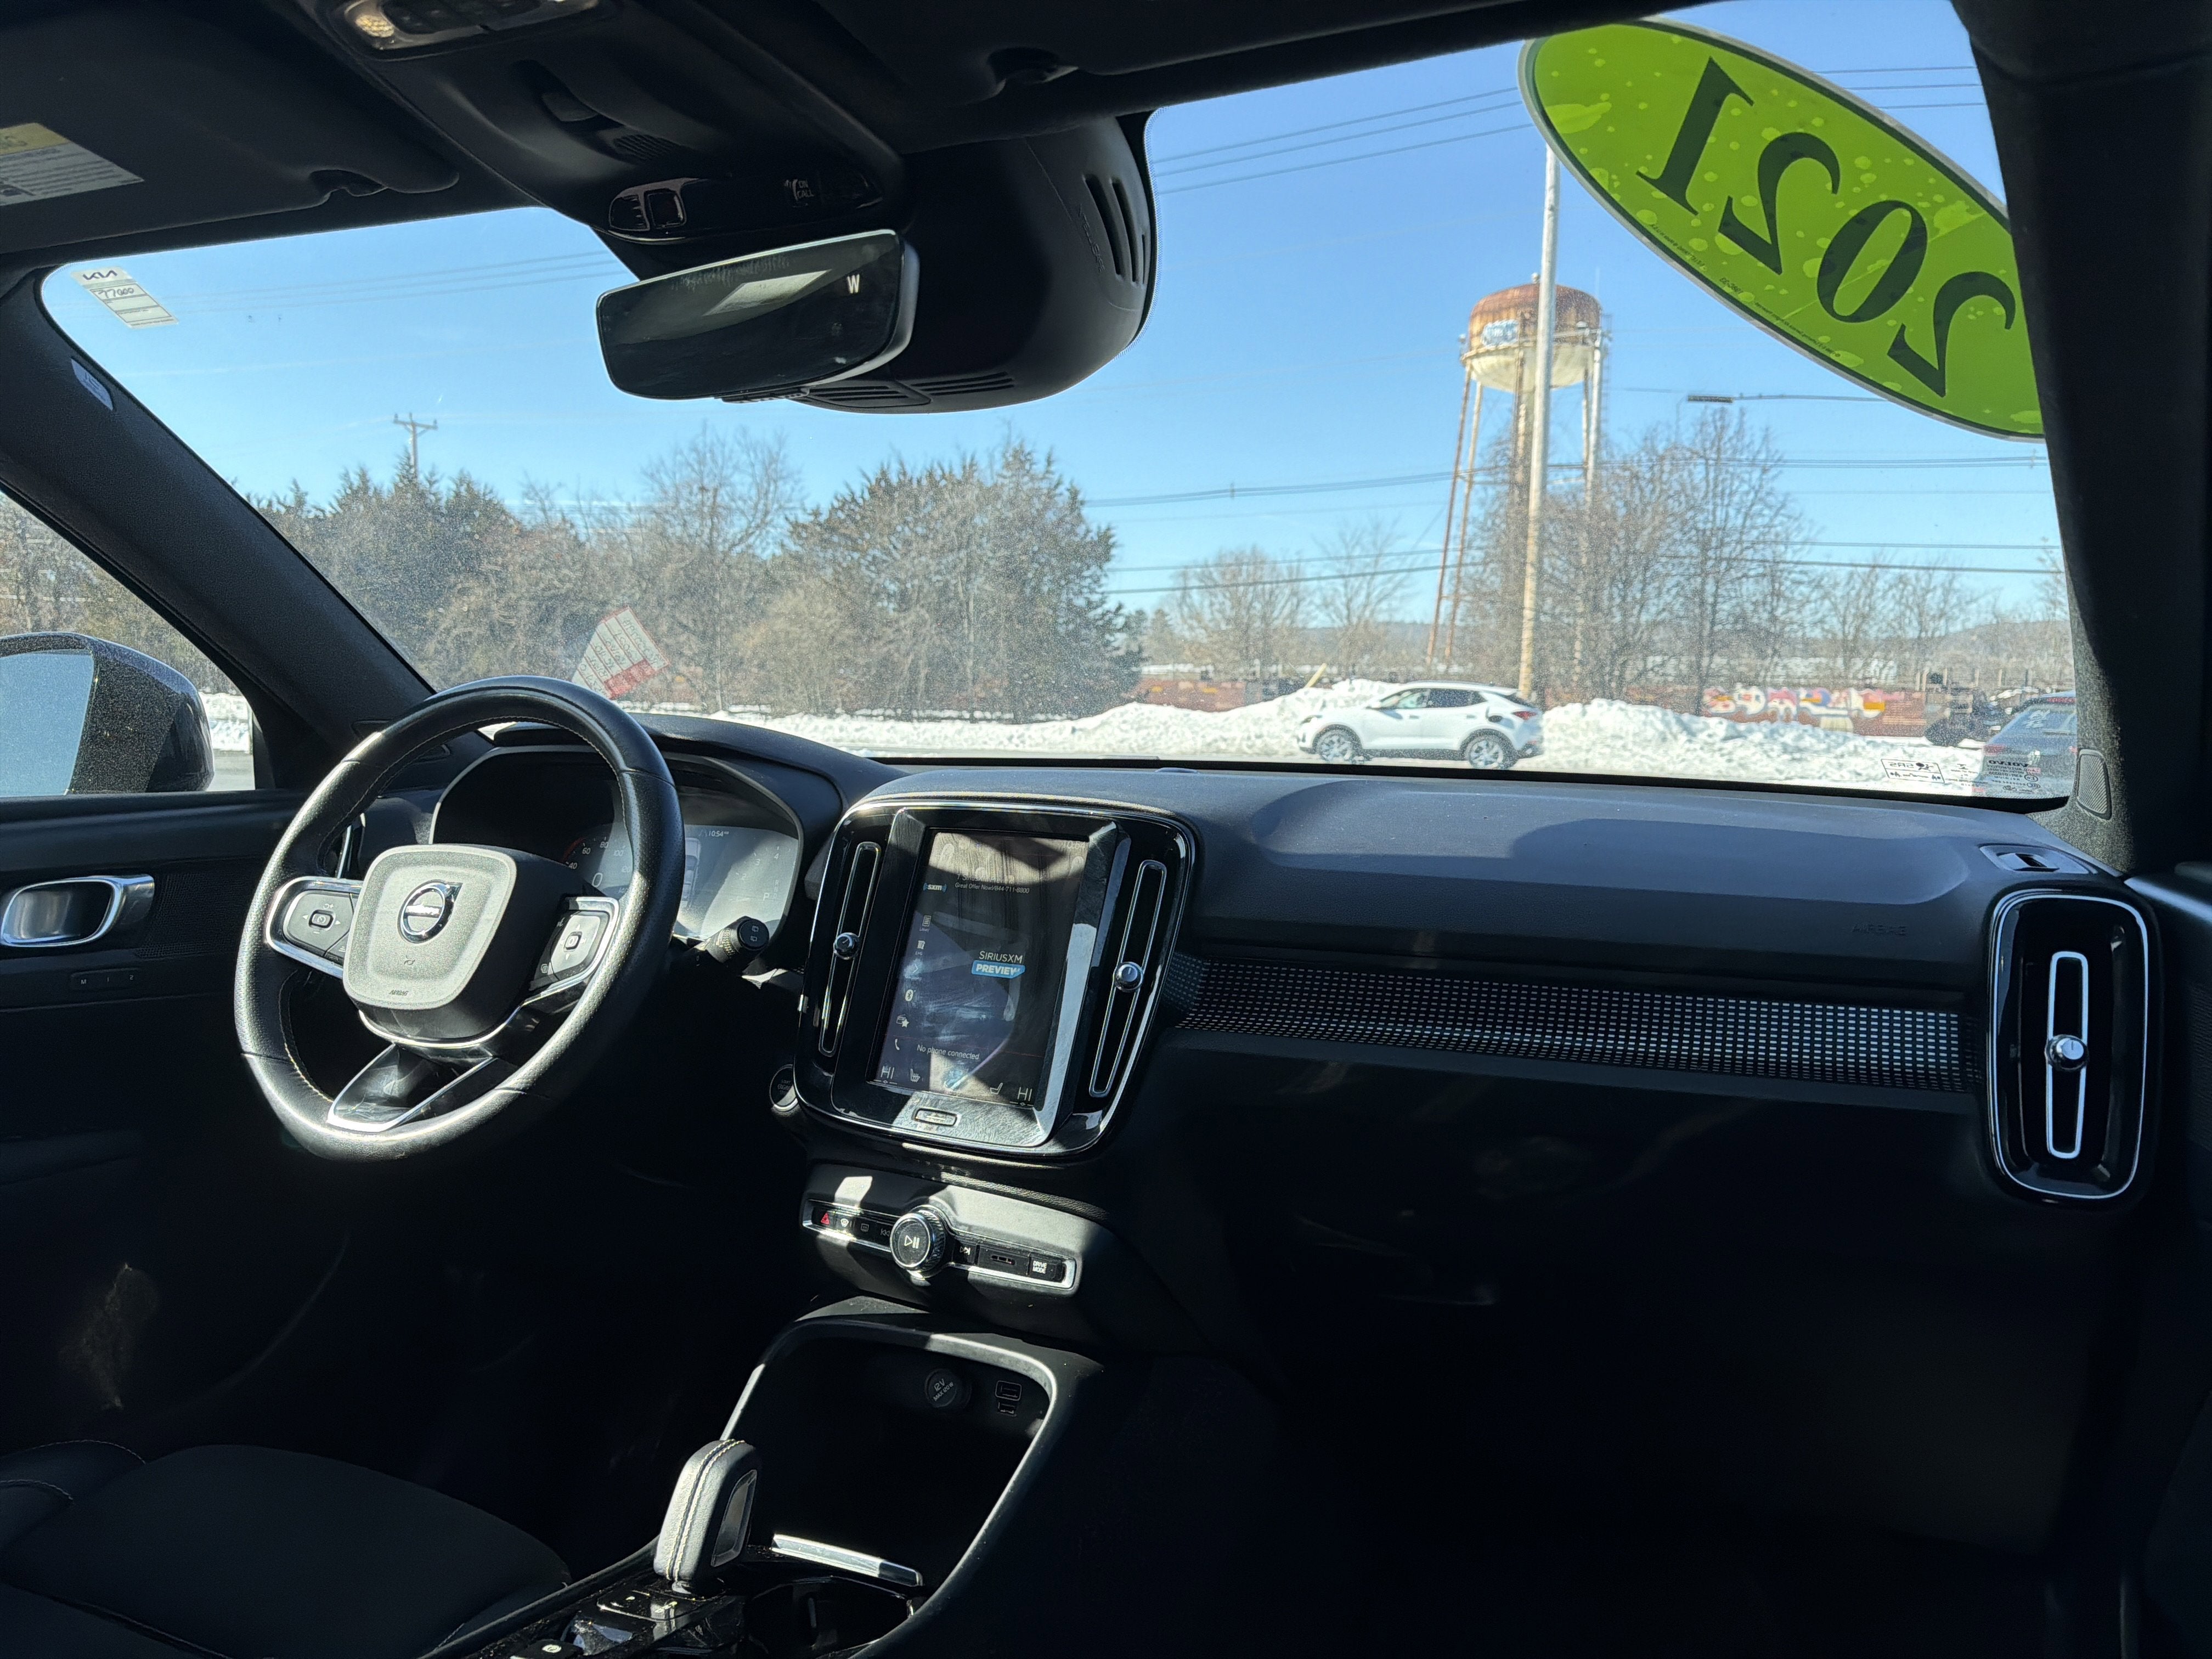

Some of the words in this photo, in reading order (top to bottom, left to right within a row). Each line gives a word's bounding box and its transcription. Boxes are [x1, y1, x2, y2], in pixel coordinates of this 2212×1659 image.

[798, 180, 809, 188] ON
[797, 189, 815, 199] CALL
[82, 270, 117, 280] KIA
[847, 274, 860, 294] W
[592, 872, 603, 888] 0
[763, 893, 769, 901] P
[979, 950, 1023, 964] SIRIUSXM
[975, 963, 1020, 975] PREVIEW
[917, 1044, 926, 1052] No
[927, 1047, 946, 1056] phone
[947, 1050, 980, 1060] connected
[880, 1065, 895, 1079] HI
[1018, 1086, 1032, 1102] HI
[934, 1378, 945, 1392] 12V
[933, 1390, 944, 1402] MAX
